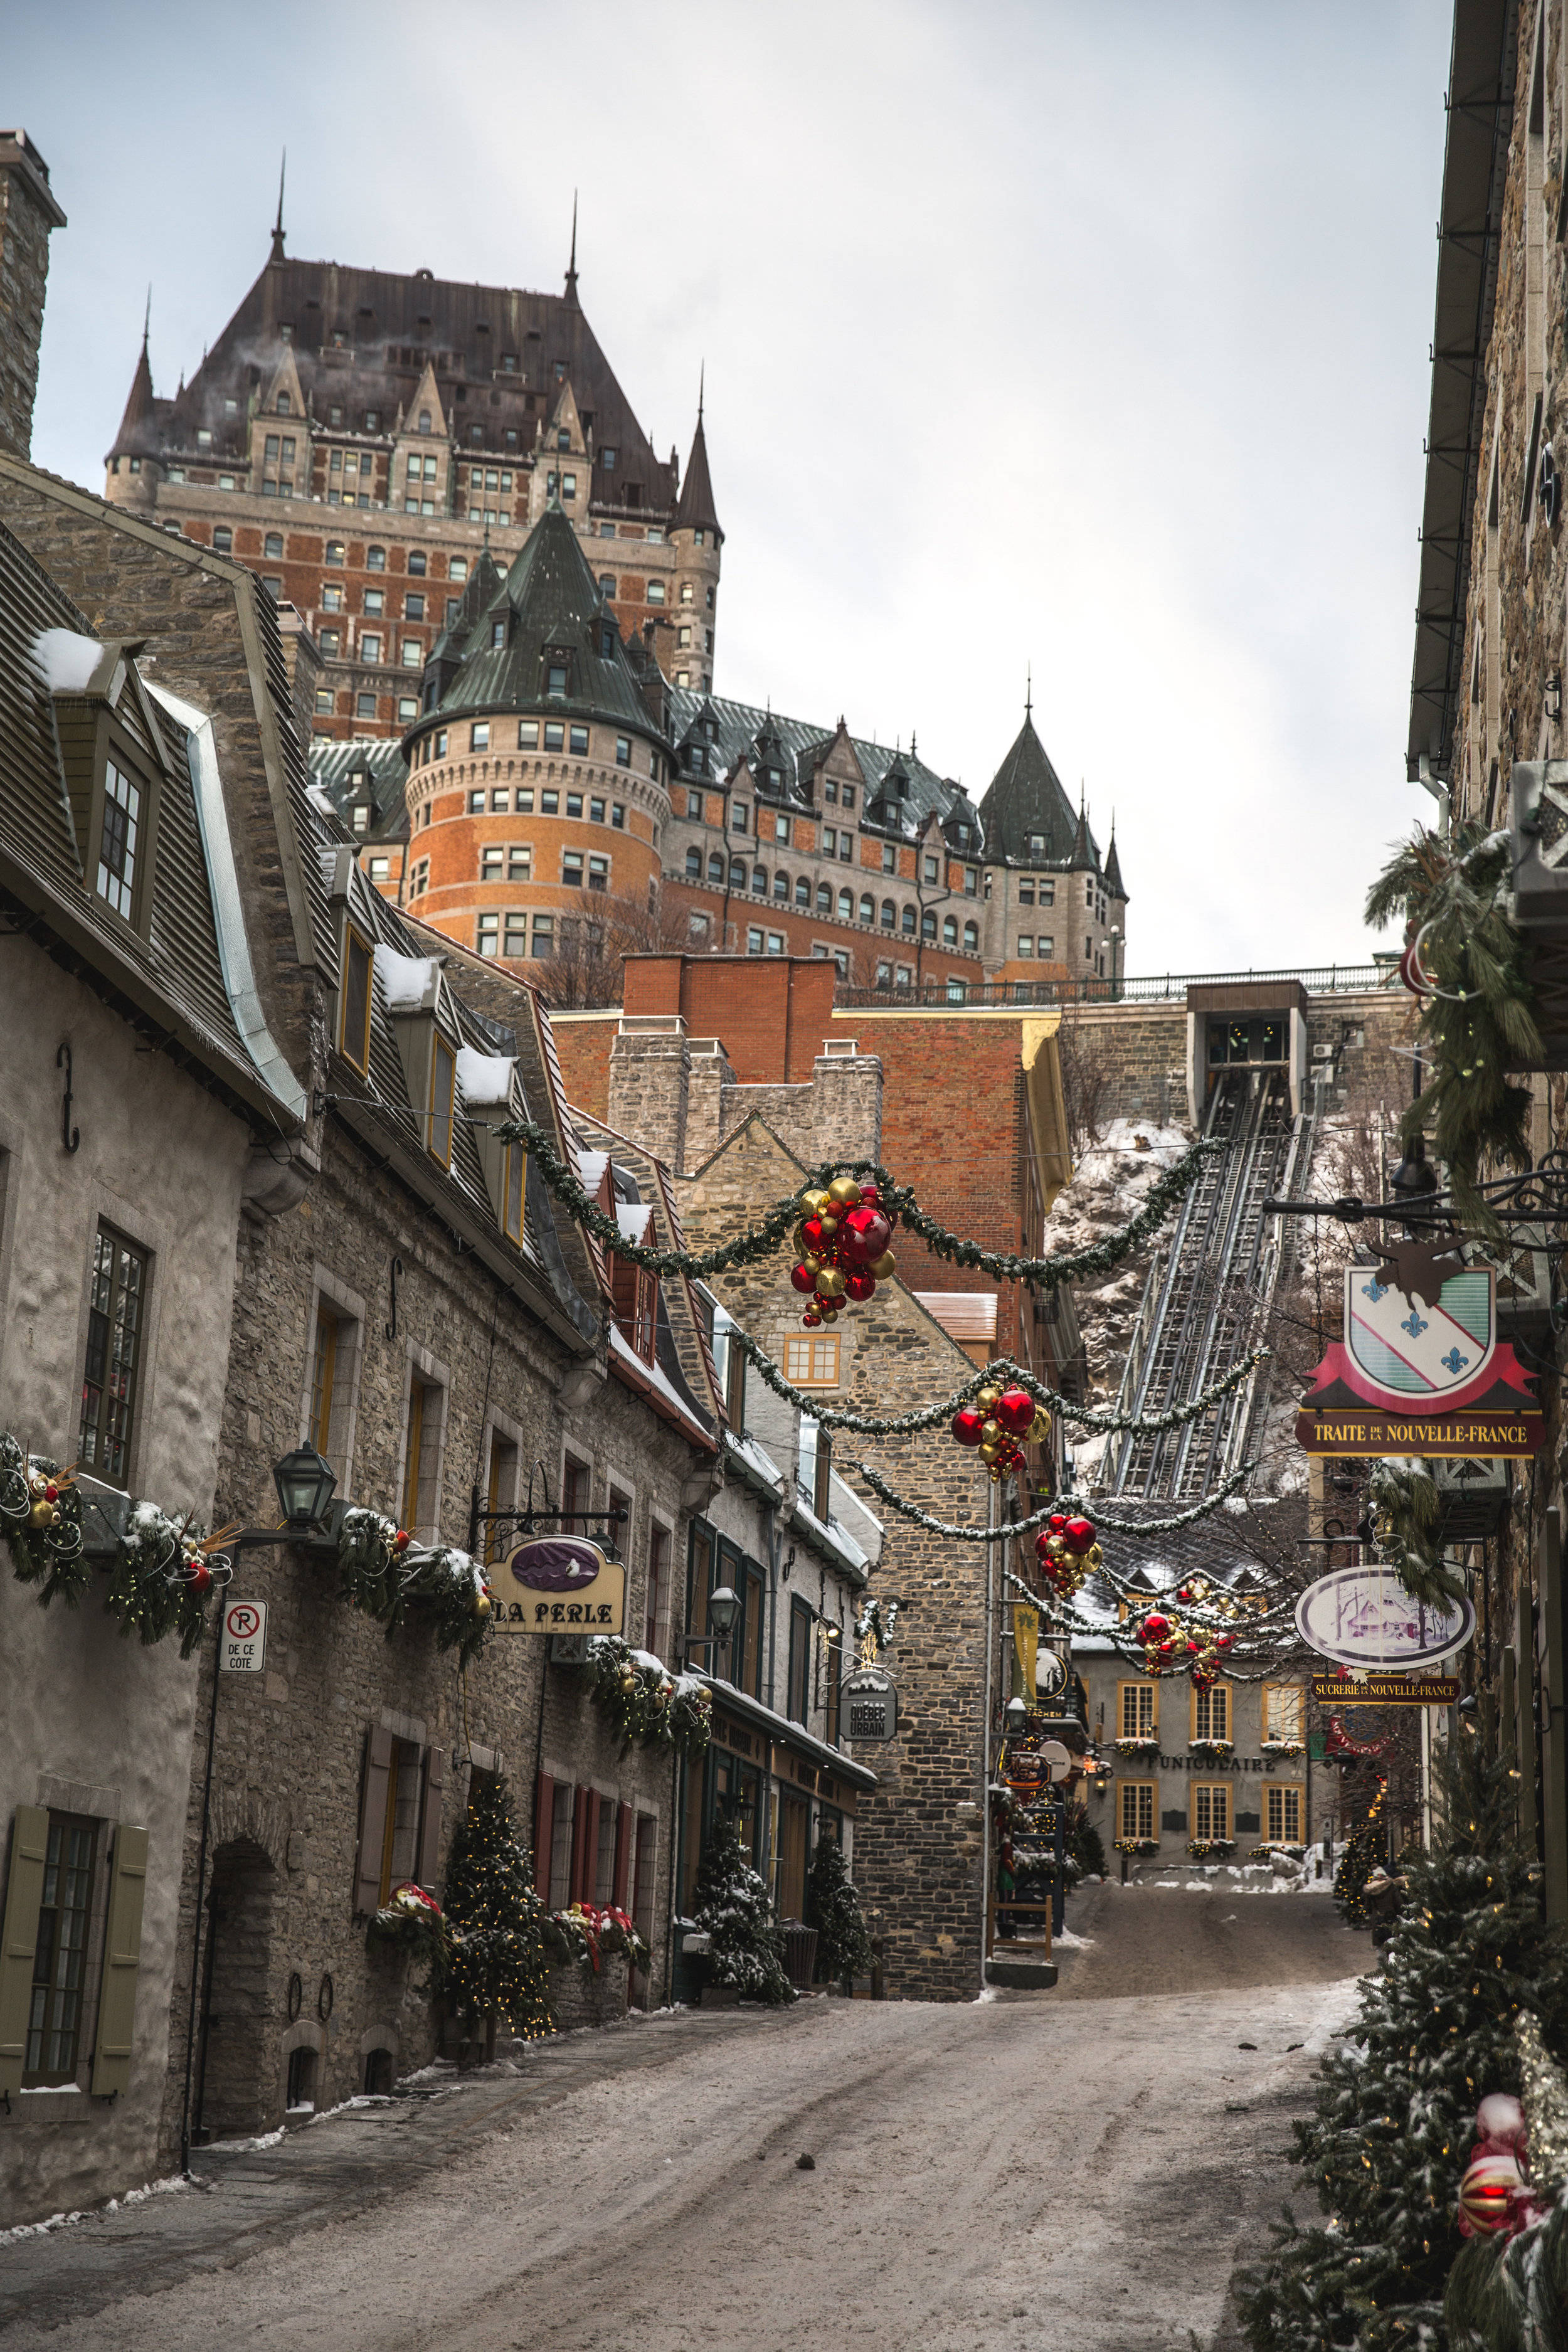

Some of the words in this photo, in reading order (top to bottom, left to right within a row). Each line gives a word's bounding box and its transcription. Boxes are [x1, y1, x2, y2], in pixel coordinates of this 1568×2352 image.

[1314, 1424, 1366, 1441] TRAITE
[1386, 1425, 1527, 1443] NOUVELLE-FRANCE
[494, 1602, 526, 1622] LA
[535, 1602, 613, 1623] PERLE
[228, 1644, 240, 1655] DE
[243, 1644, 255, 1655] CE
[1316, 1684, 1359, 1695] SUCRERIE
[1370, 1685, 1454, 1696] NOUVELLE-FRANCE
[850, 1722, 884, 1737] URBAIN
